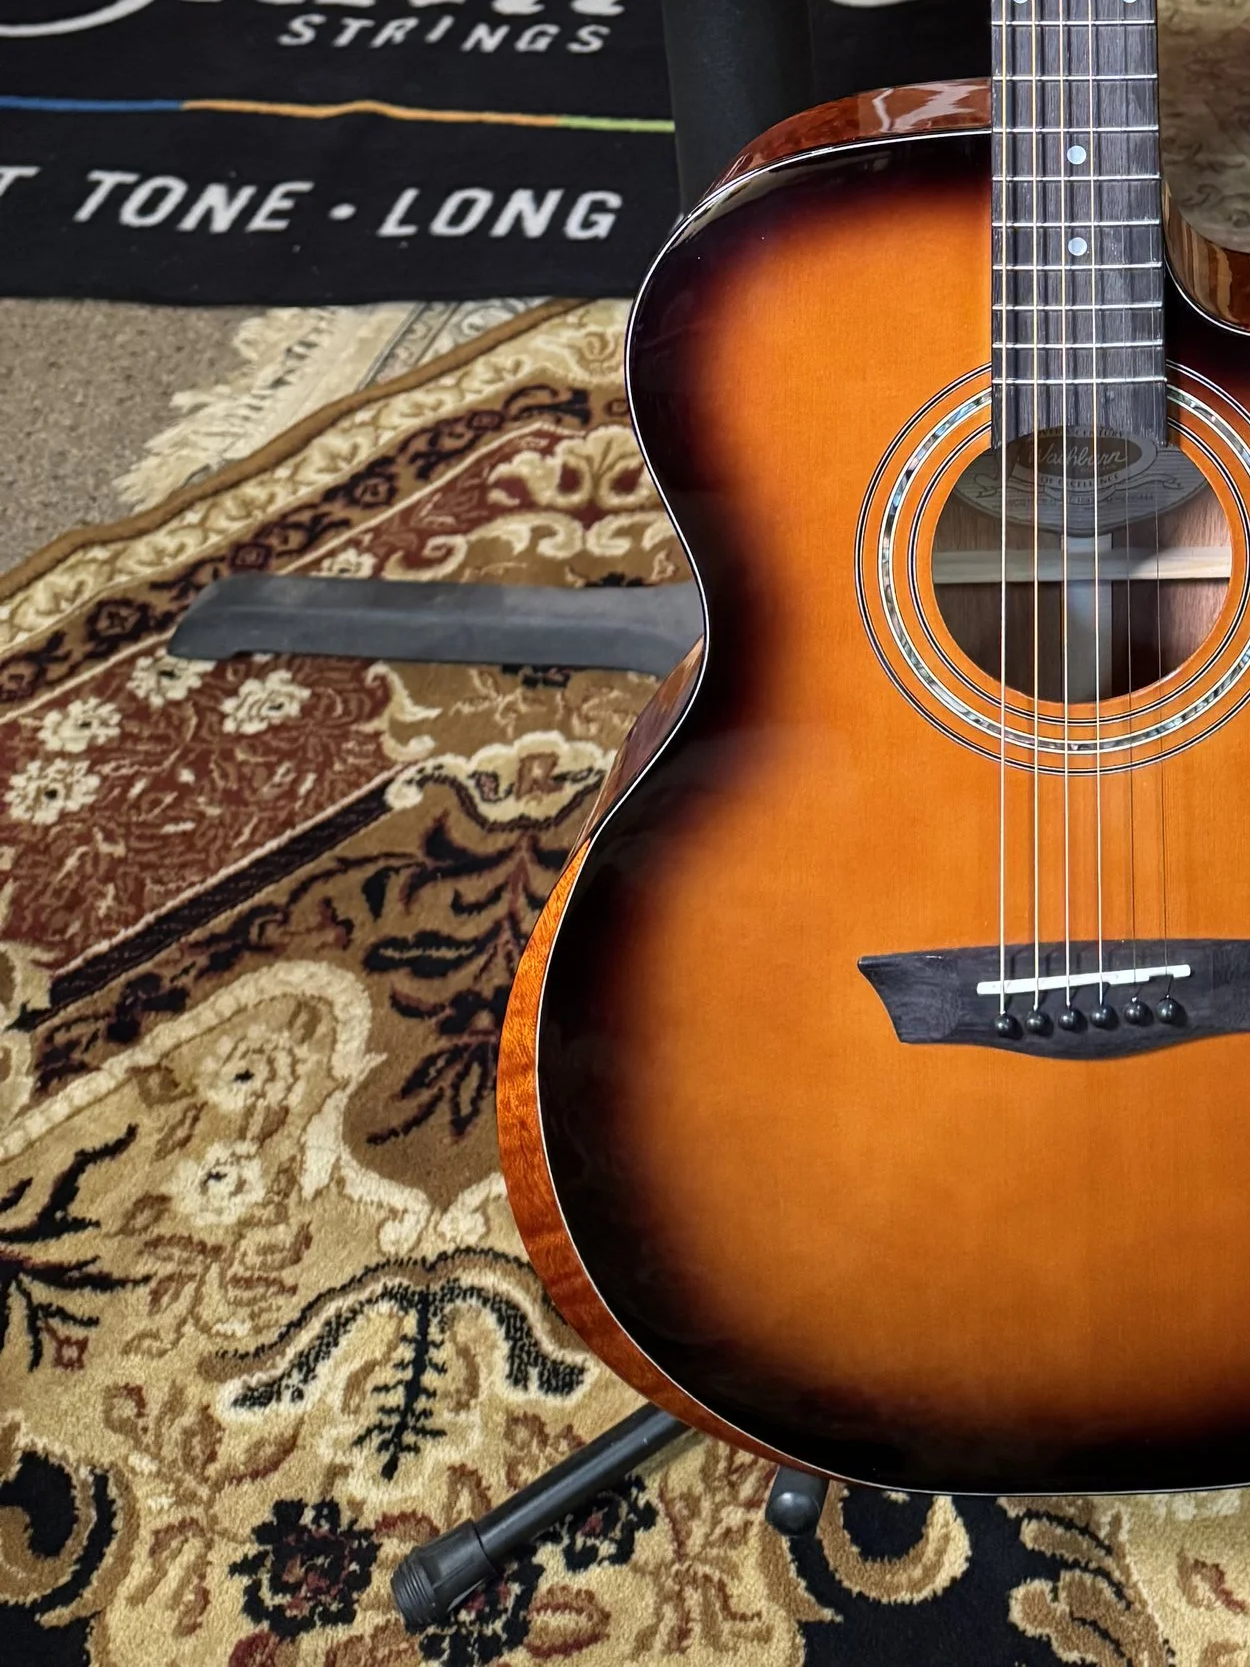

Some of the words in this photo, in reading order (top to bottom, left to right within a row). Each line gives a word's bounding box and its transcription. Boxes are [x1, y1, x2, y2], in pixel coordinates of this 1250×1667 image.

[278, 15, 610, 53] STRINGS
[74, 170, 313, 232] TONE
[377, 189, 623, 239] LONG
